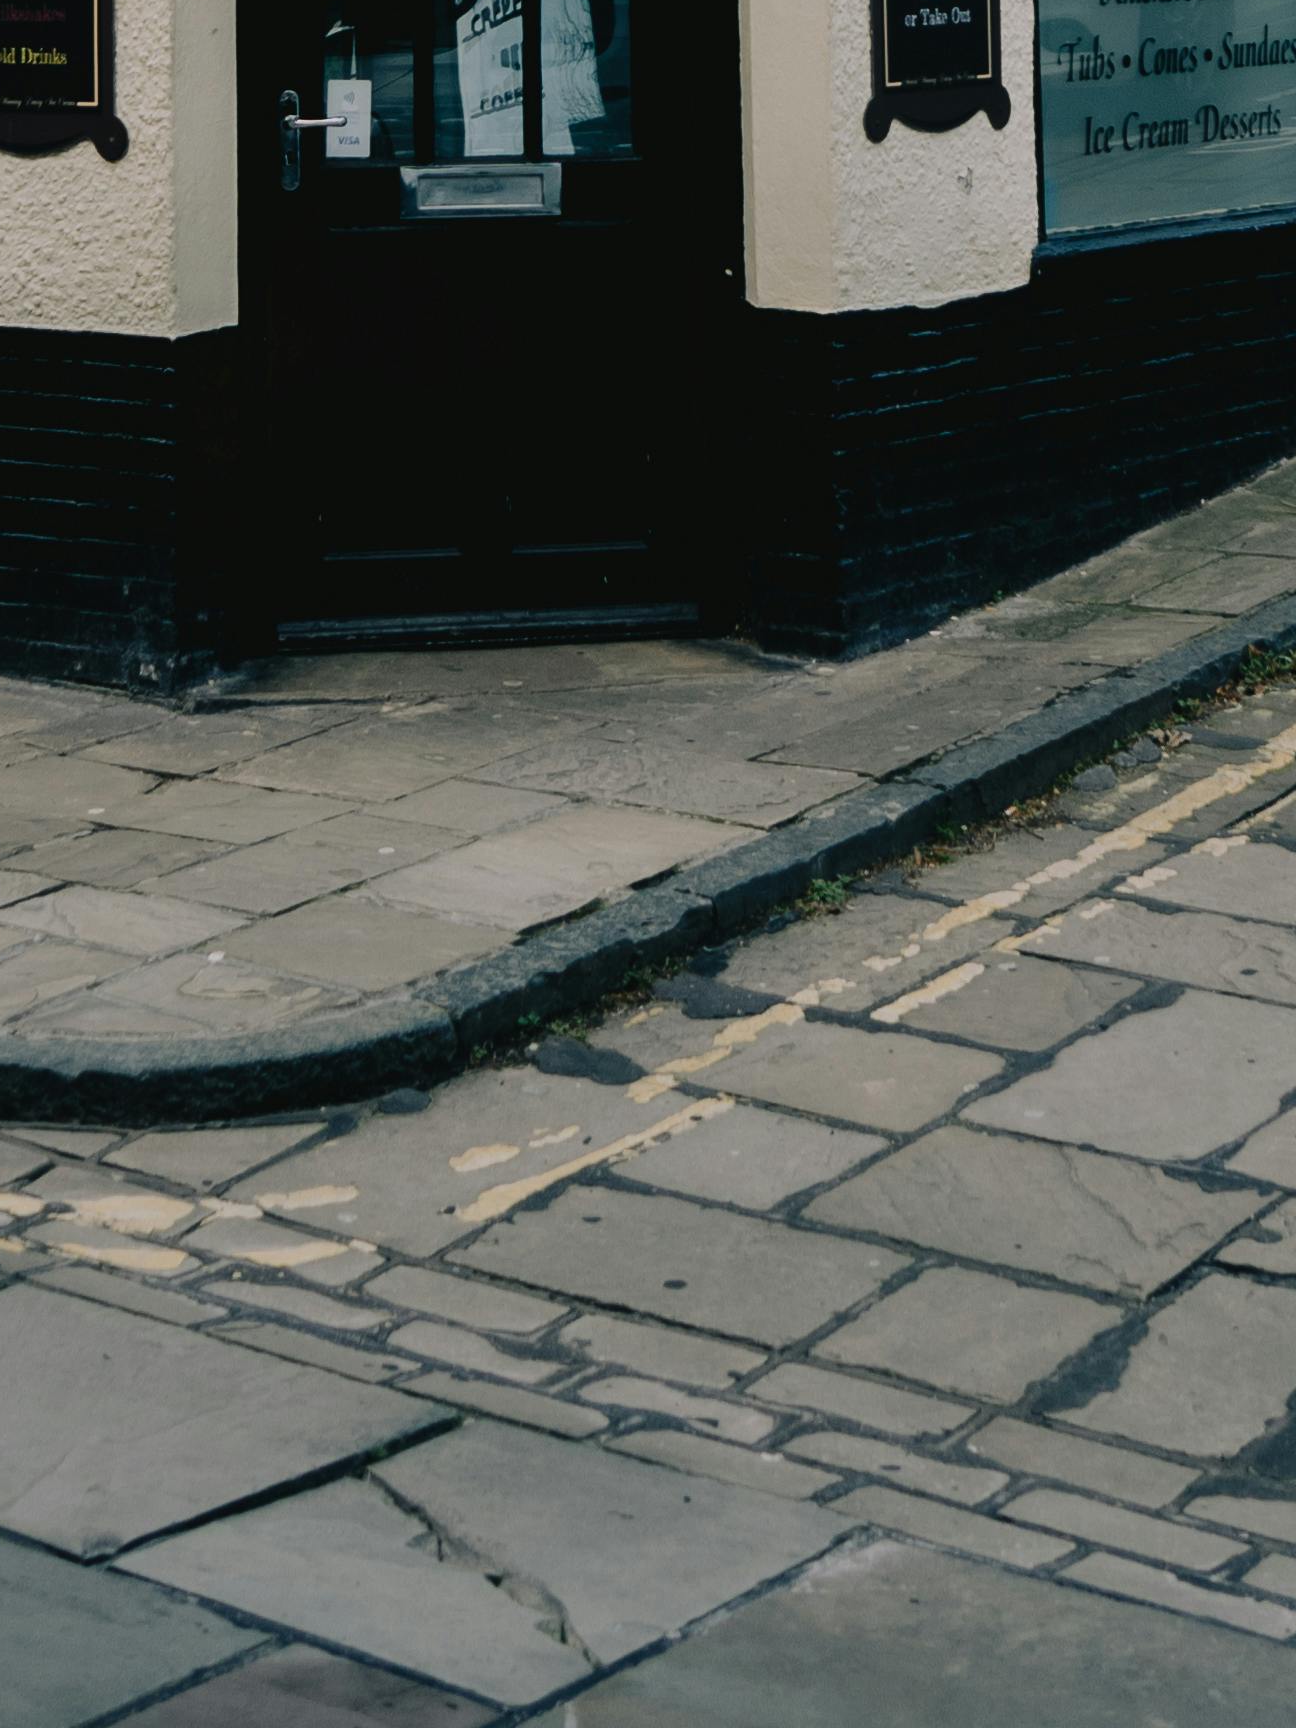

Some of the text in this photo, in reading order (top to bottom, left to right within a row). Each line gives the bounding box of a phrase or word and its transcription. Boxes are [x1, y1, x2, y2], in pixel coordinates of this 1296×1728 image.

[904, 6, 972, 29] or Take Out
[20, 46, 67, 66] Drinks
[1056, 33, 1116, 84] Tubs
[1137, 36, 1199, 78] Cones
[337, 135, 360, 145] VISA
[1083, 103, 1282, 156] Ice Cream Desserts
